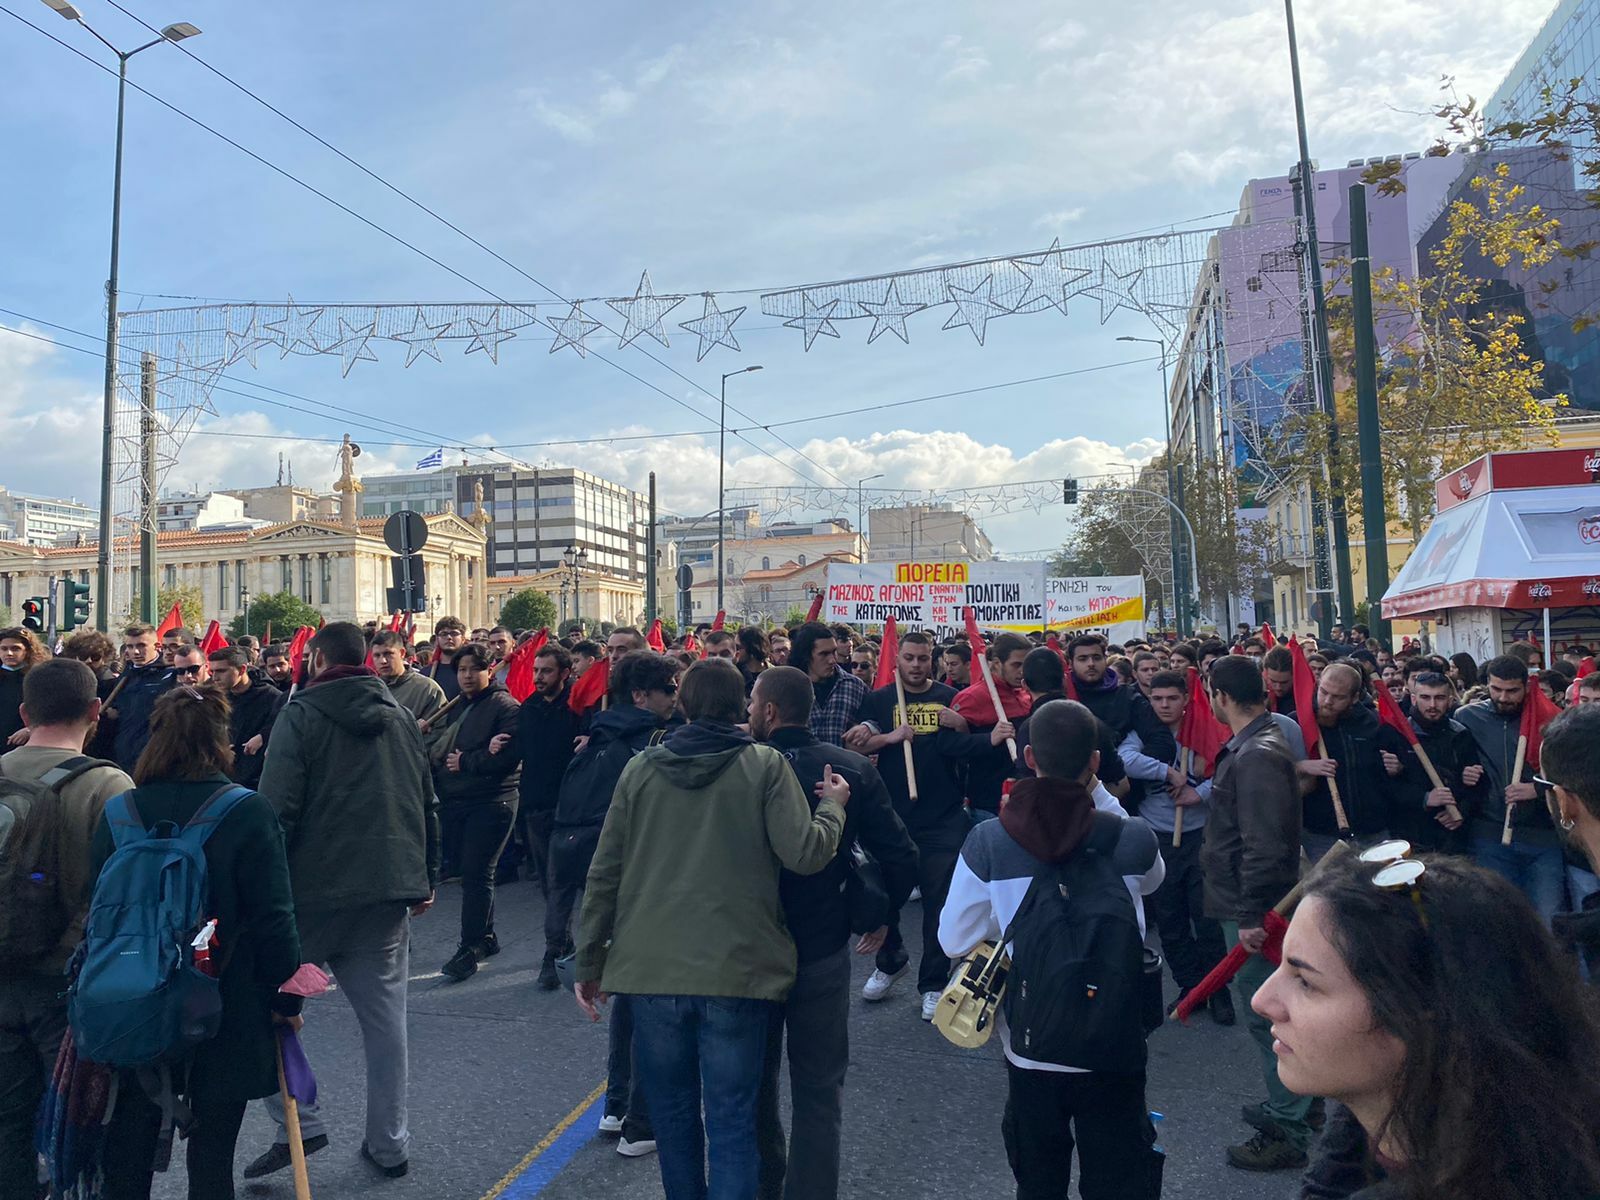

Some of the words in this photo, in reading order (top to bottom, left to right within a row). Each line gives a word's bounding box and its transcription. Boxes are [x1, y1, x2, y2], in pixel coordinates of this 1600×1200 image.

[898, 563, 965, 583] ΠΟΡΕΙΑ
[829, 584, 875, 602] ΜΑΖΙΚΟΣ
[929, 584, 964, 595] ΕΝΑΝΤΙΑ
[965, 583, 1020, 604] ΠΟΛΙΤΙΚΗ
[932, 595, 957, 604] ΣΤΗΝ
[832, 605, 848, 615] ΤΗΣ
[932, 606, 948, 615] ΚΑΙ
[932, 615, 948, 623] ΤΗΣ
